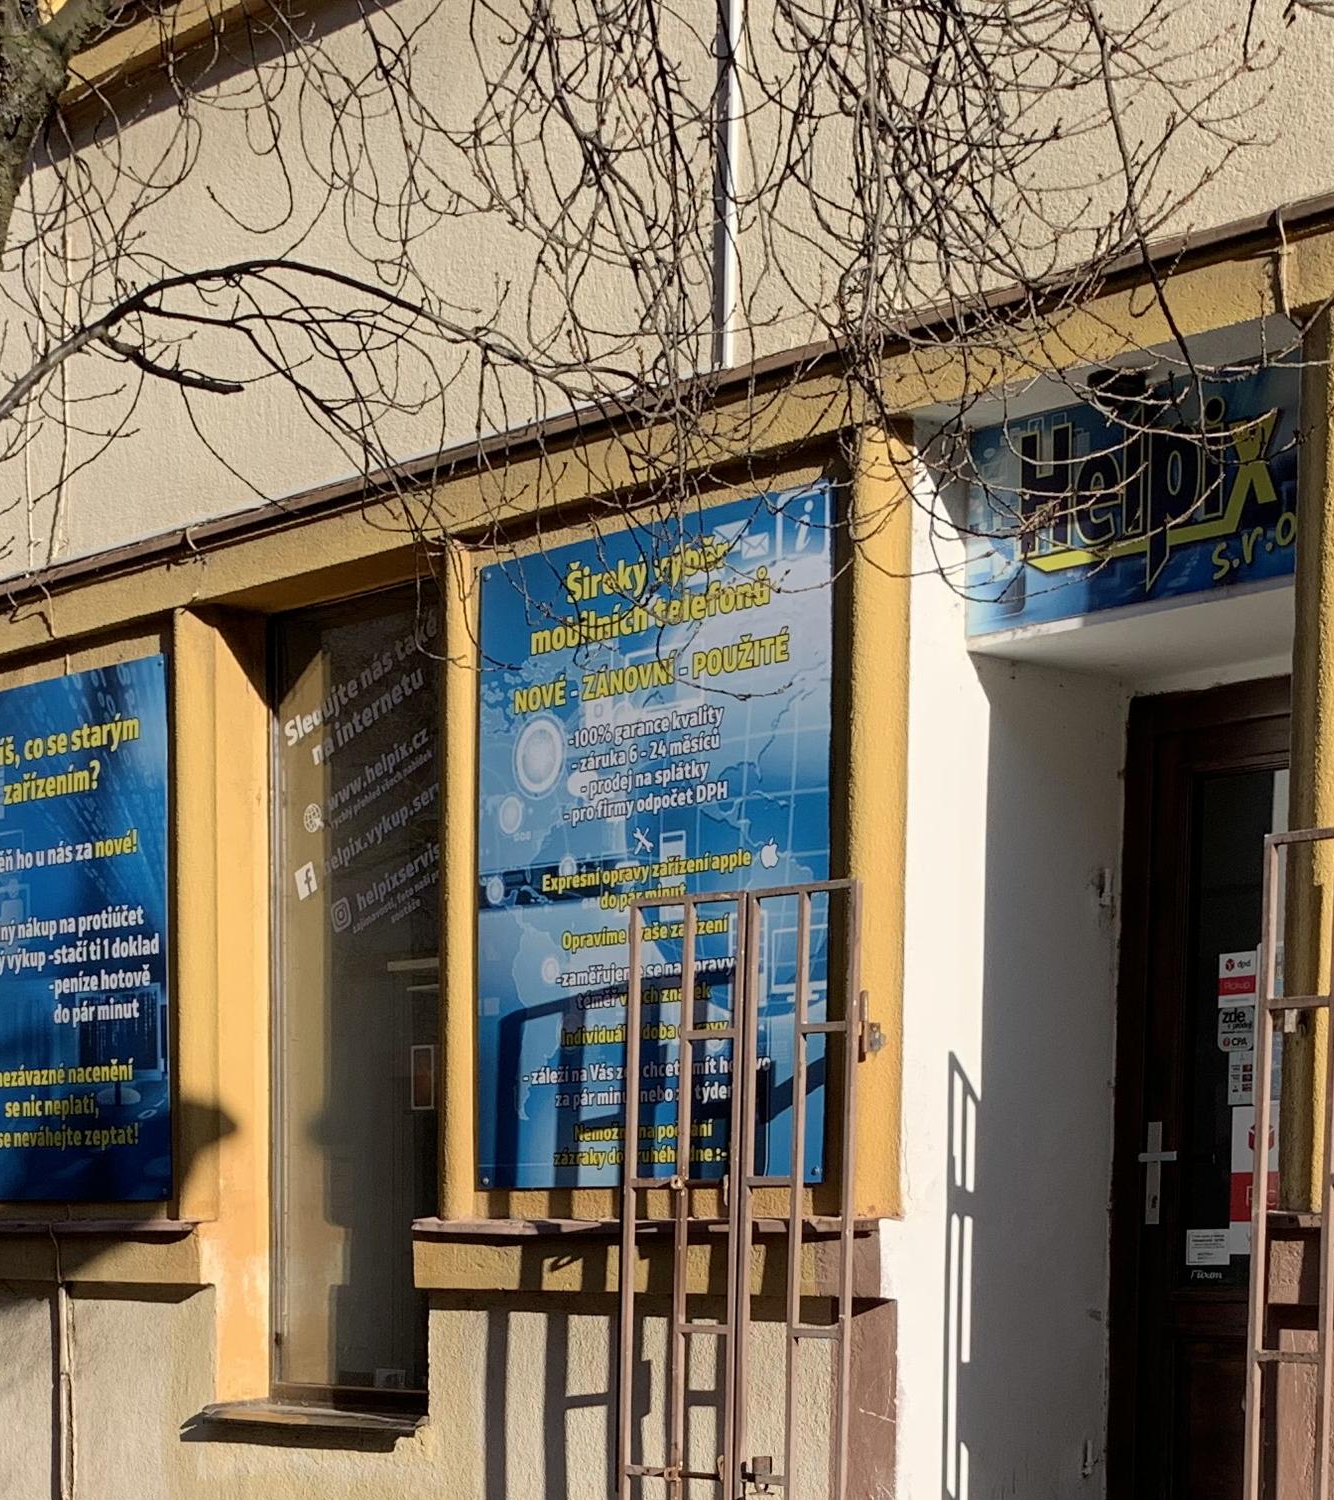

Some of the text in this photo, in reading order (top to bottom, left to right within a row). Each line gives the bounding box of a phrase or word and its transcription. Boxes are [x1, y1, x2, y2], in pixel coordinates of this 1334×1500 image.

[1018, 397, 1281, 593] Helpix
[566, 553, 649, 604] Široký
[530, 565, 771, 656] mobilních telefonů
[360, 651, 394, 689] nás
[514, 626, 790, 715] NOVÉ ZÁNOVNÍ POUŽITÉ
[312, 667, 424, 766] na internetu
[614, 717, 669, 745] garance
[672, 704, 724, 731] kvality
[24, 737, 44, 761] co
[47, 732, 68, 757] se
[71, 713, 140, 752] starým
[579, 728, 720, 772] záruka 6 24 měsíců
[3, 759, 101, 806] zařízením?
[589, 761, 709, 800] prodej na splátky
[572, 781, 729, 828] pro firmy odpočet DPH
[17, 848, 32, 869] ho
[36, 850, 45, 866] u
[48, 841, 73, 865] nás
[75, 843, 92, 861] za
[95, 829, 139, 857] nové!
[542, 848, 752, 895] Expresní opravy zařízení apple
[600, 890, 619, 910] do
[18, 917, 57, 941] nákup
[59, 916, 76, 932] na
[78, 905, 144, 937] protiúčet
[562, 927, 626, 954] Opravíme
[7, 948, 46, 974] výkup
[90, 941, 101, 959] ti
[103, 938, 109, 959] 1
[111, 933, 160, 958] doklad
[644, 963, 682, 978] se na
[100, 964, 151, 990] hotově
[54, 997, 140, 1027] do pár minut
[1222, 1009, 1246, 1024] zde
[68, 1058, 134, 1082] nacenění
[590, 1063, 614, 1082] Vás
[5, 1100, 20, 1118] se
[22, 1094, 42, 1116] nic
[13, 1123, 82, 1150] neváhejte
[85, 1122, 139, 1150] zeptat!
